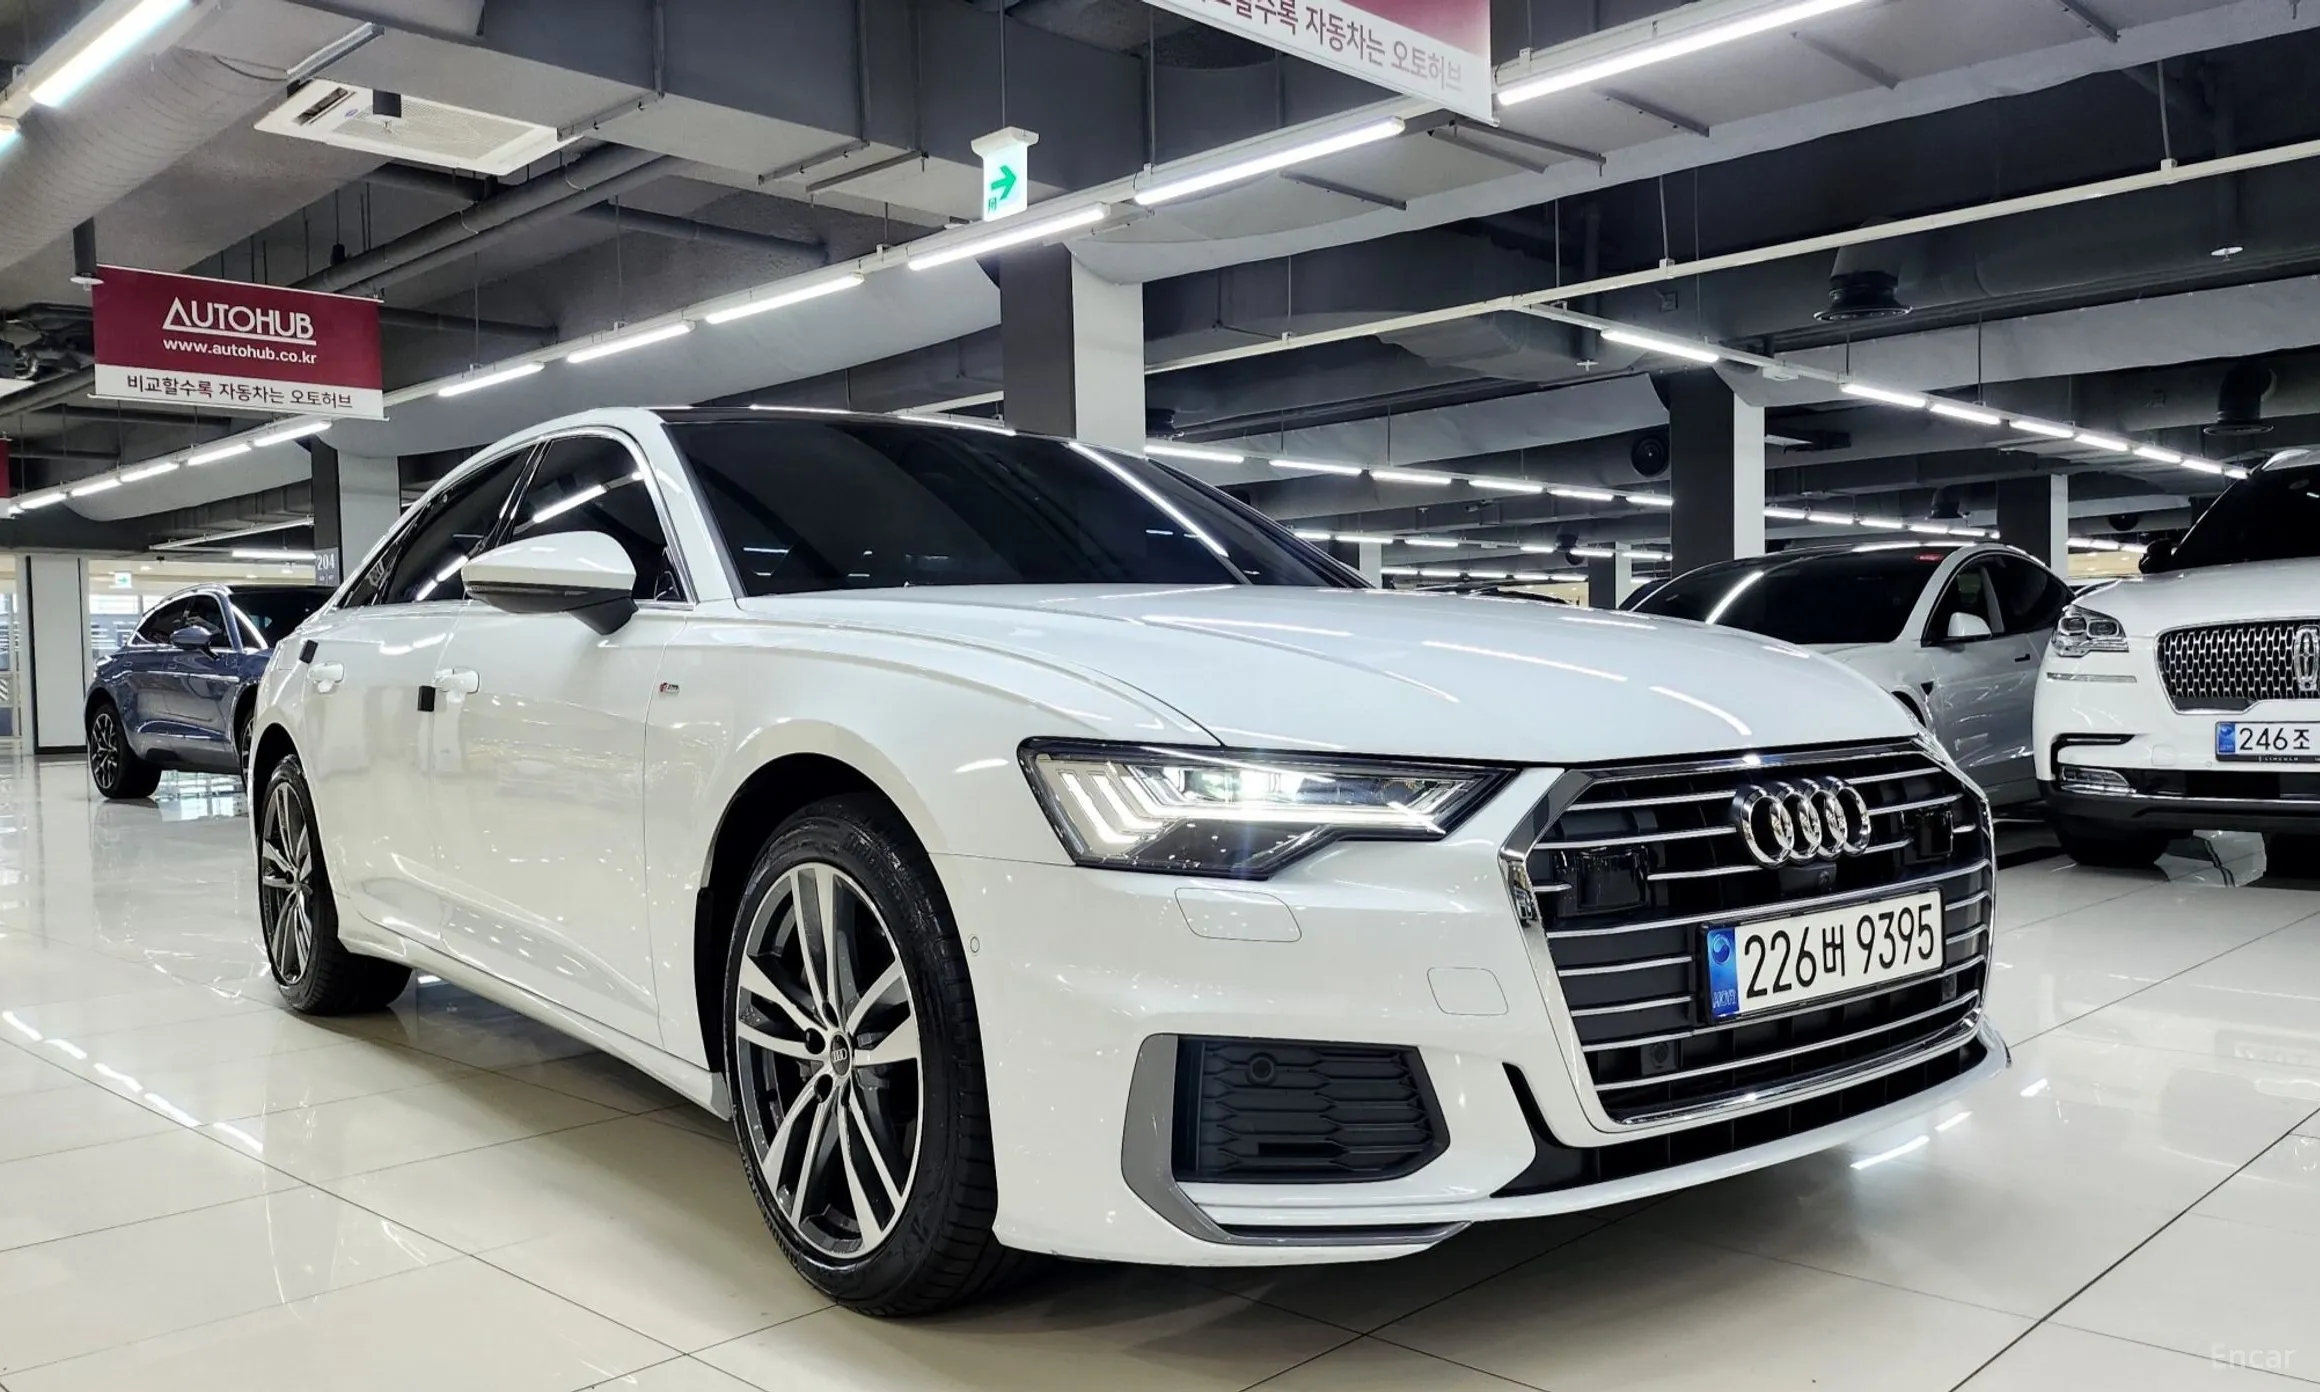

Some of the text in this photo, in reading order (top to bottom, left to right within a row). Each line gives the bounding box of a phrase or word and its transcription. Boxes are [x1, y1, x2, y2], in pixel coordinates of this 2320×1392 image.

[1305, 6, 1385, 67] 자동차는
[1391, 40, 1463, 92] 오토허브
[162, 296, 316, 341] AUTOHUB
[163, 338, 317, 365] www.autohub.co.kr
[127, 374, 353, 409] 비교할수록 자동차는 오토허브
[317, 553, 335, 570] 204
[2239, 727, 2310, 751] 246조
[1744, 903, 1935, 999] 226버 9395
